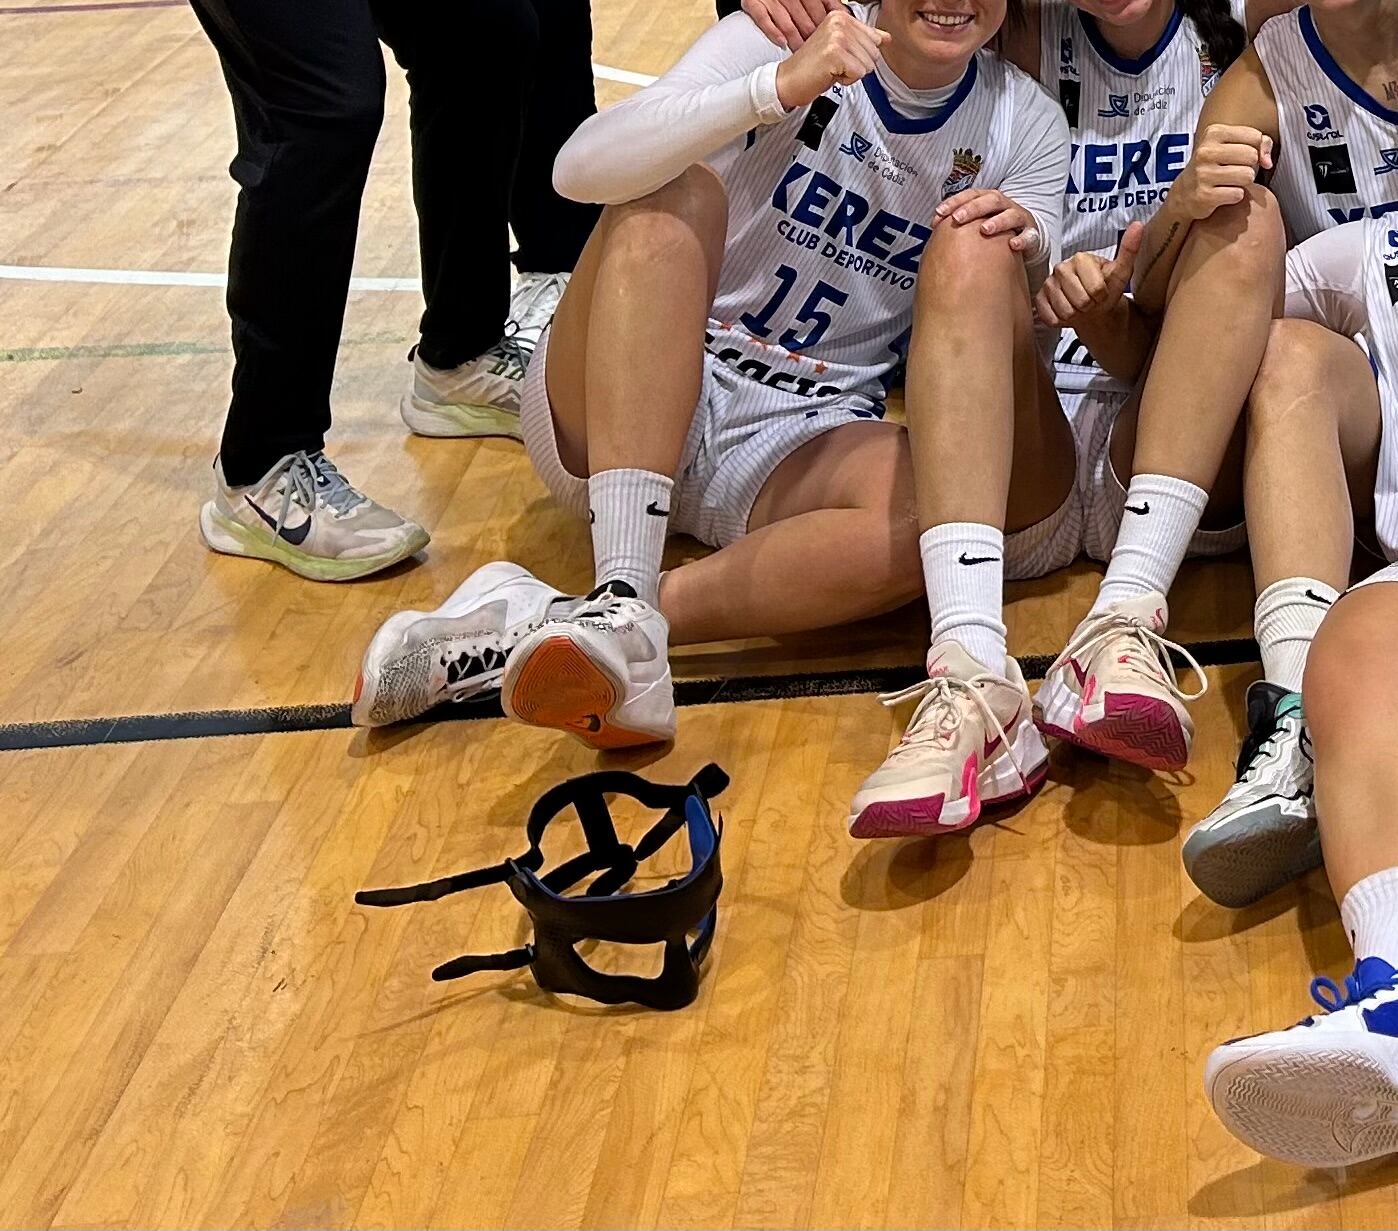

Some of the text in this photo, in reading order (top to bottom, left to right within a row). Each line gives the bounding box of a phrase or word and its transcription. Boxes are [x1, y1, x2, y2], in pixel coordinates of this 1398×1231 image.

[1133, 106, 1145, 116] de
[1065, 133, 1190, 195] ERE
[1076, 194, 1119, 214] CLUB
[777, 219, 916, 291] CLUB DEPORTIVO
[739, 263, 850, 353] 15
